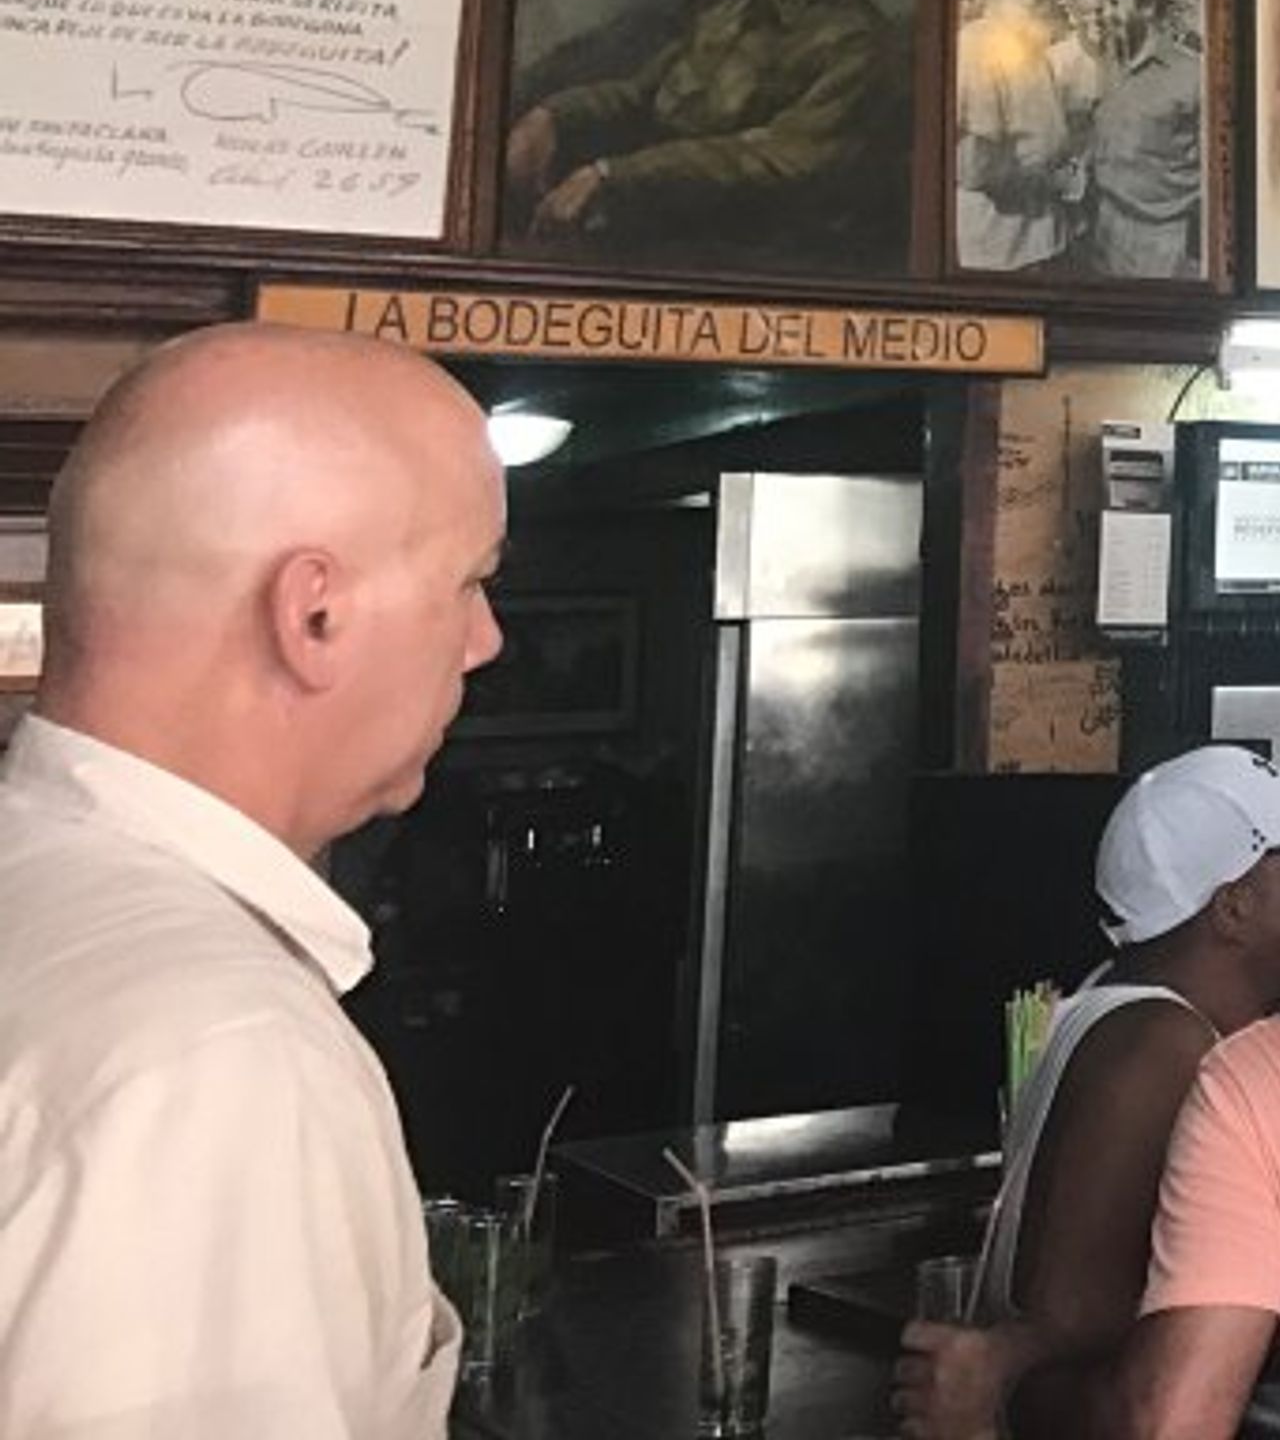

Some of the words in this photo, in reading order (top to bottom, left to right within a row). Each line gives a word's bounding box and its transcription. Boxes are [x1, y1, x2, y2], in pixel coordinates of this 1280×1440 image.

[426, 298, 723, 356] BODEGUITA
[738, 311, 824, 358] DEL
[841, 317, 988, 364] MEDIO
